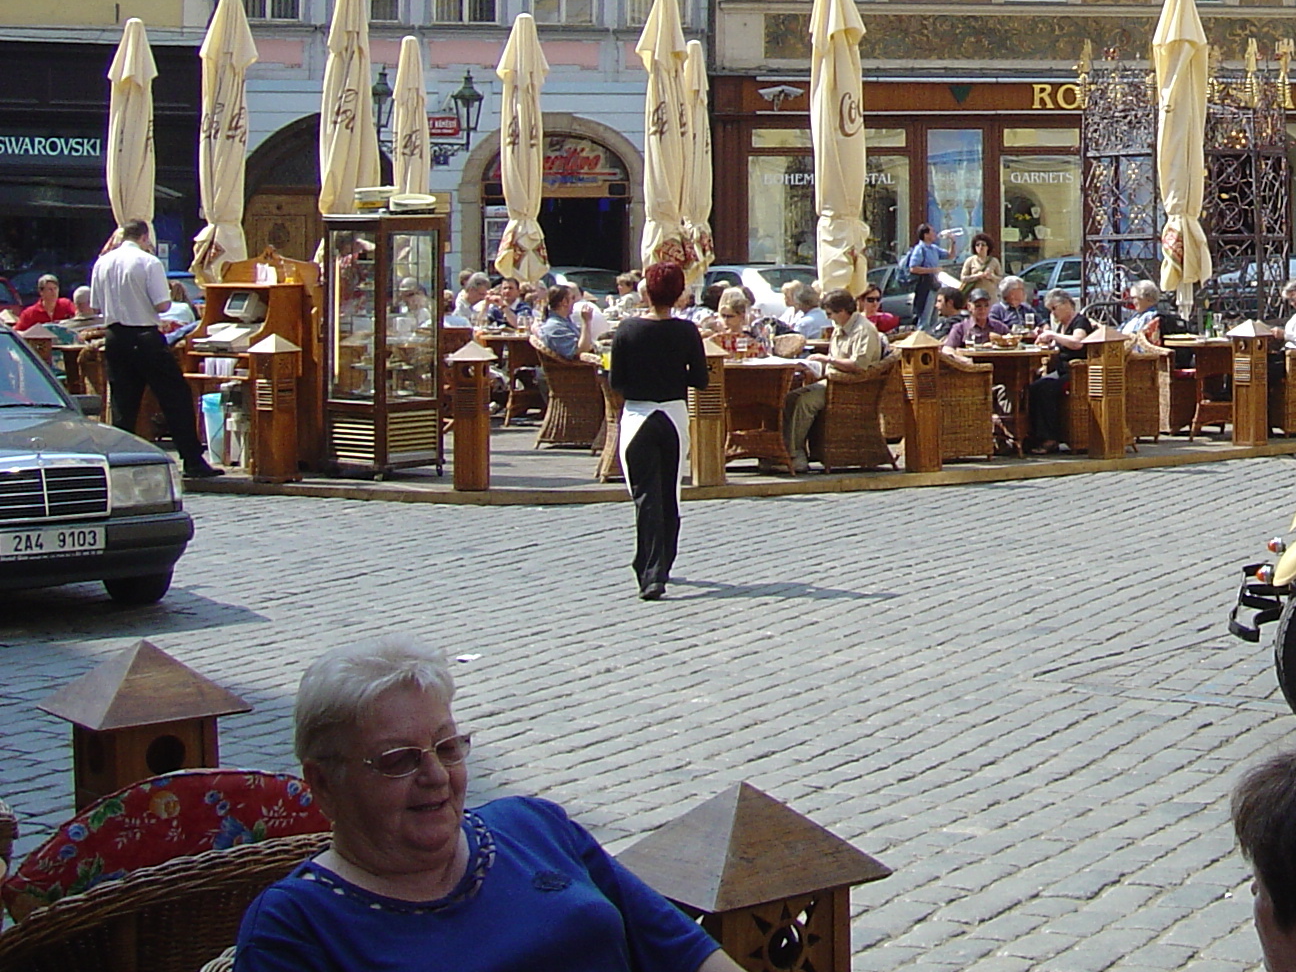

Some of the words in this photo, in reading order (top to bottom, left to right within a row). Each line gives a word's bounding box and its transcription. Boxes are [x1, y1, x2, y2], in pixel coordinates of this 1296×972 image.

[0, 136, 100, 156] SWAROVSKI
[1011, 172, 1074, 184] GARNETS
[13, 533, 43, 552] 2A4
[58, 530, 97, 548] 9103
